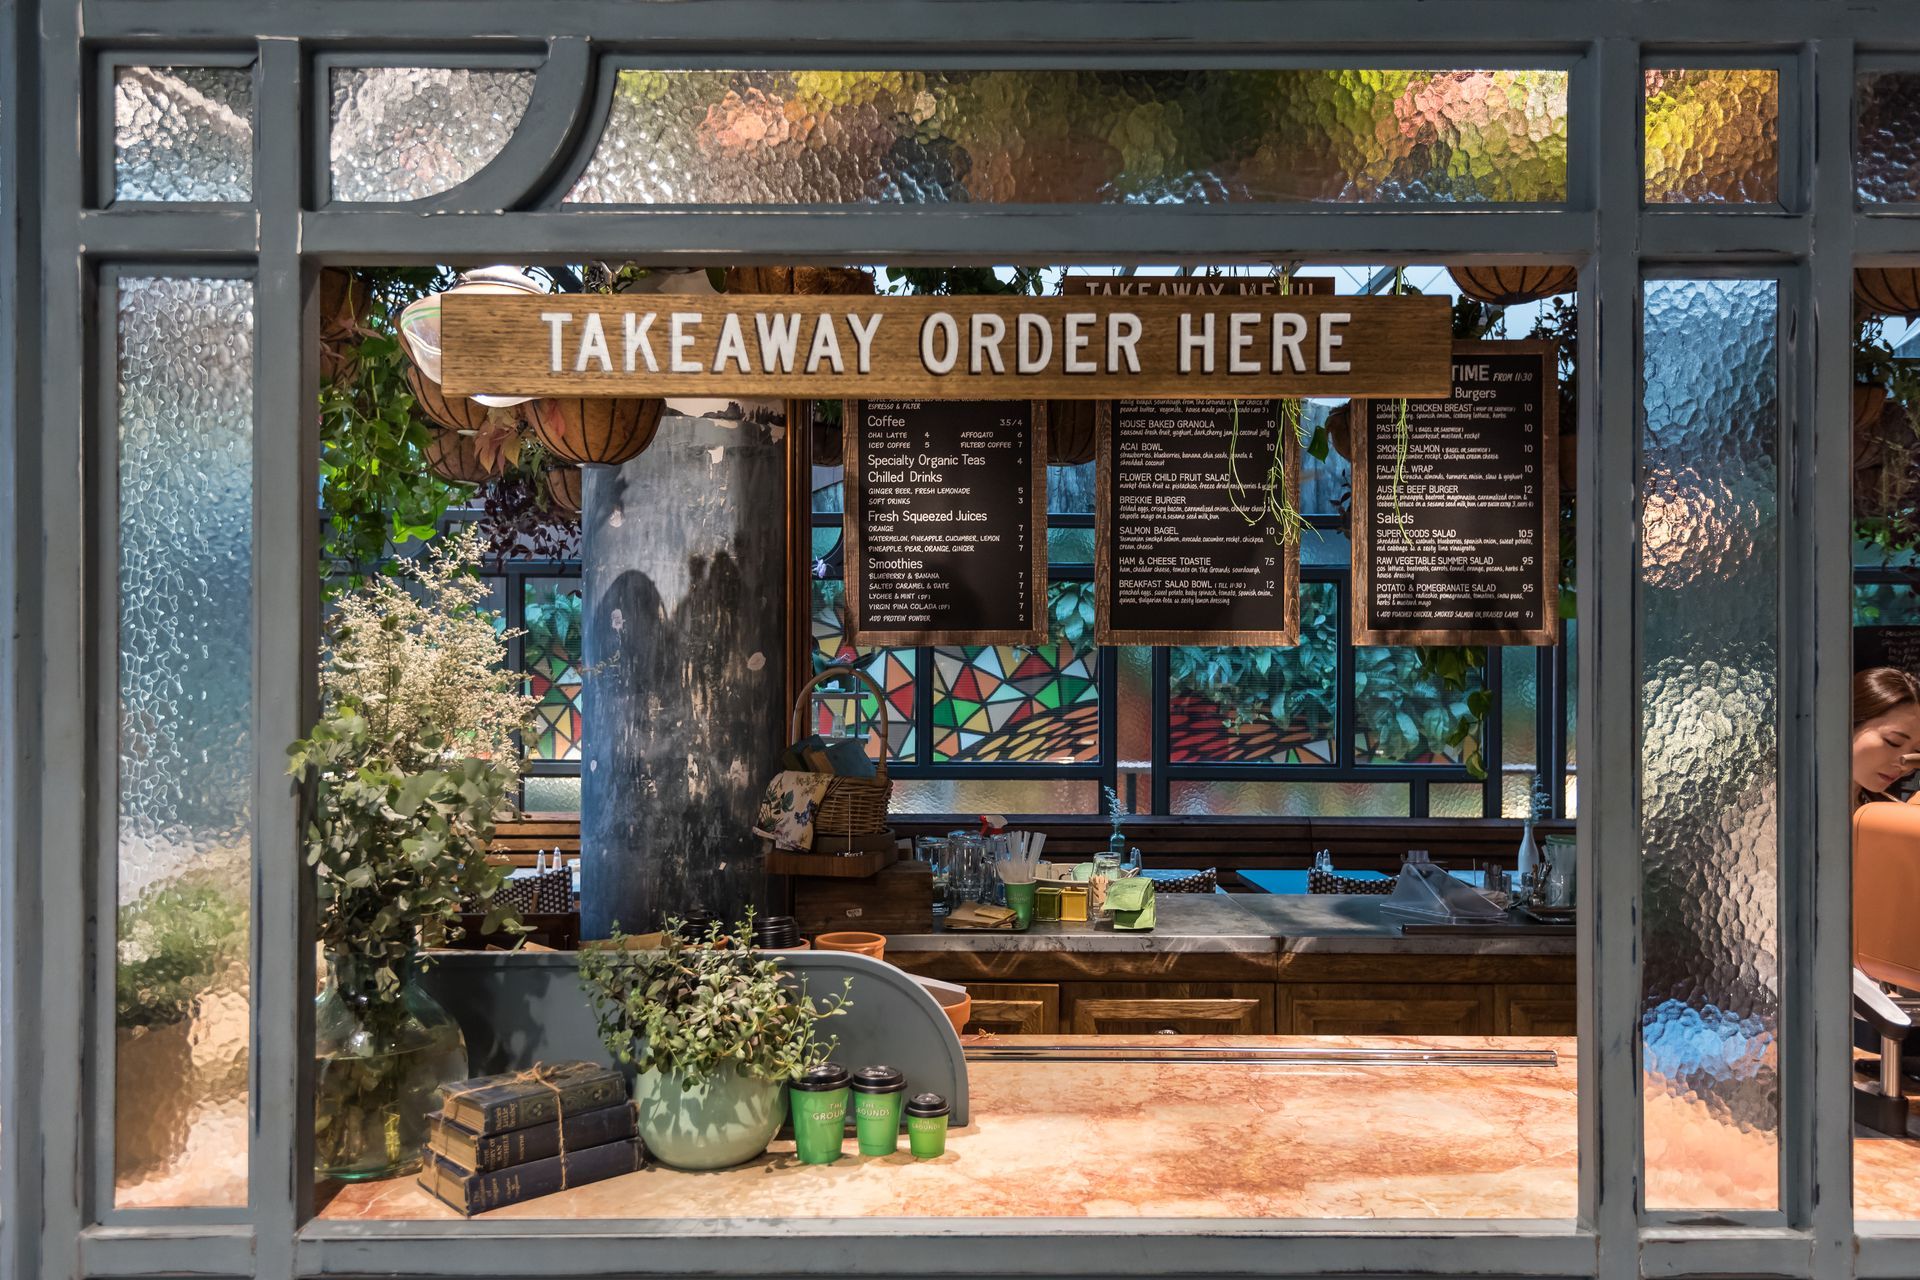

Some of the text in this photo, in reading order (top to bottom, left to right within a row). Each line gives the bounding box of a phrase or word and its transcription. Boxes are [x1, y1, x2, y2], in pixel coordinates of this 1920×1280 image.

[1240, 282, 1313, 295] MEU
[541, 312, 1351, 374] TAKEAWAY ORDER HERE
[1493, 373, 1513, 381] FROM
[1455, 387, 1496, 401] Burgers
[1525, 404, 1532, 412] 10
[868, 415, 905, 427] Coffee
[1120, 420, 1146, 428] HOUSE
[1149, 420, 1175, 428] BAKED
[1177, 420, 1215, 428] GRANOLA
[868, 454, 914, 468] Specialty
[919, 454, 958, 468] Organic
[962, 454, 986, 465] Teas
[868, 471, 942, 482] Chilled Drinks
[1120, 473, 1152, 481] FLOWER
[1154, 473, 1177, 481] CHILD
[1180, 473, 1202, 481] FRUIT
[1407, 485, 1426, 493] BEEF
[1429, 485, 1458, 493] BURGER
[1120, 496, 1186, 504] BREKKIE BURGER
[869, 510, 987, 524] Fresh Squeezed Juices
[1377, 512, 1414, 524] Salads
[869, 558, 922, 569] Smoothies
[1119, 557, 1135, 565] HAM
[1139, 557, 1144, 565] &
[1147, 557, 1177, 565] CHEESE
[1180, 557, 1211, 565] TOASTIE
[1395, 557, 1436, 565] VEGETABLE
